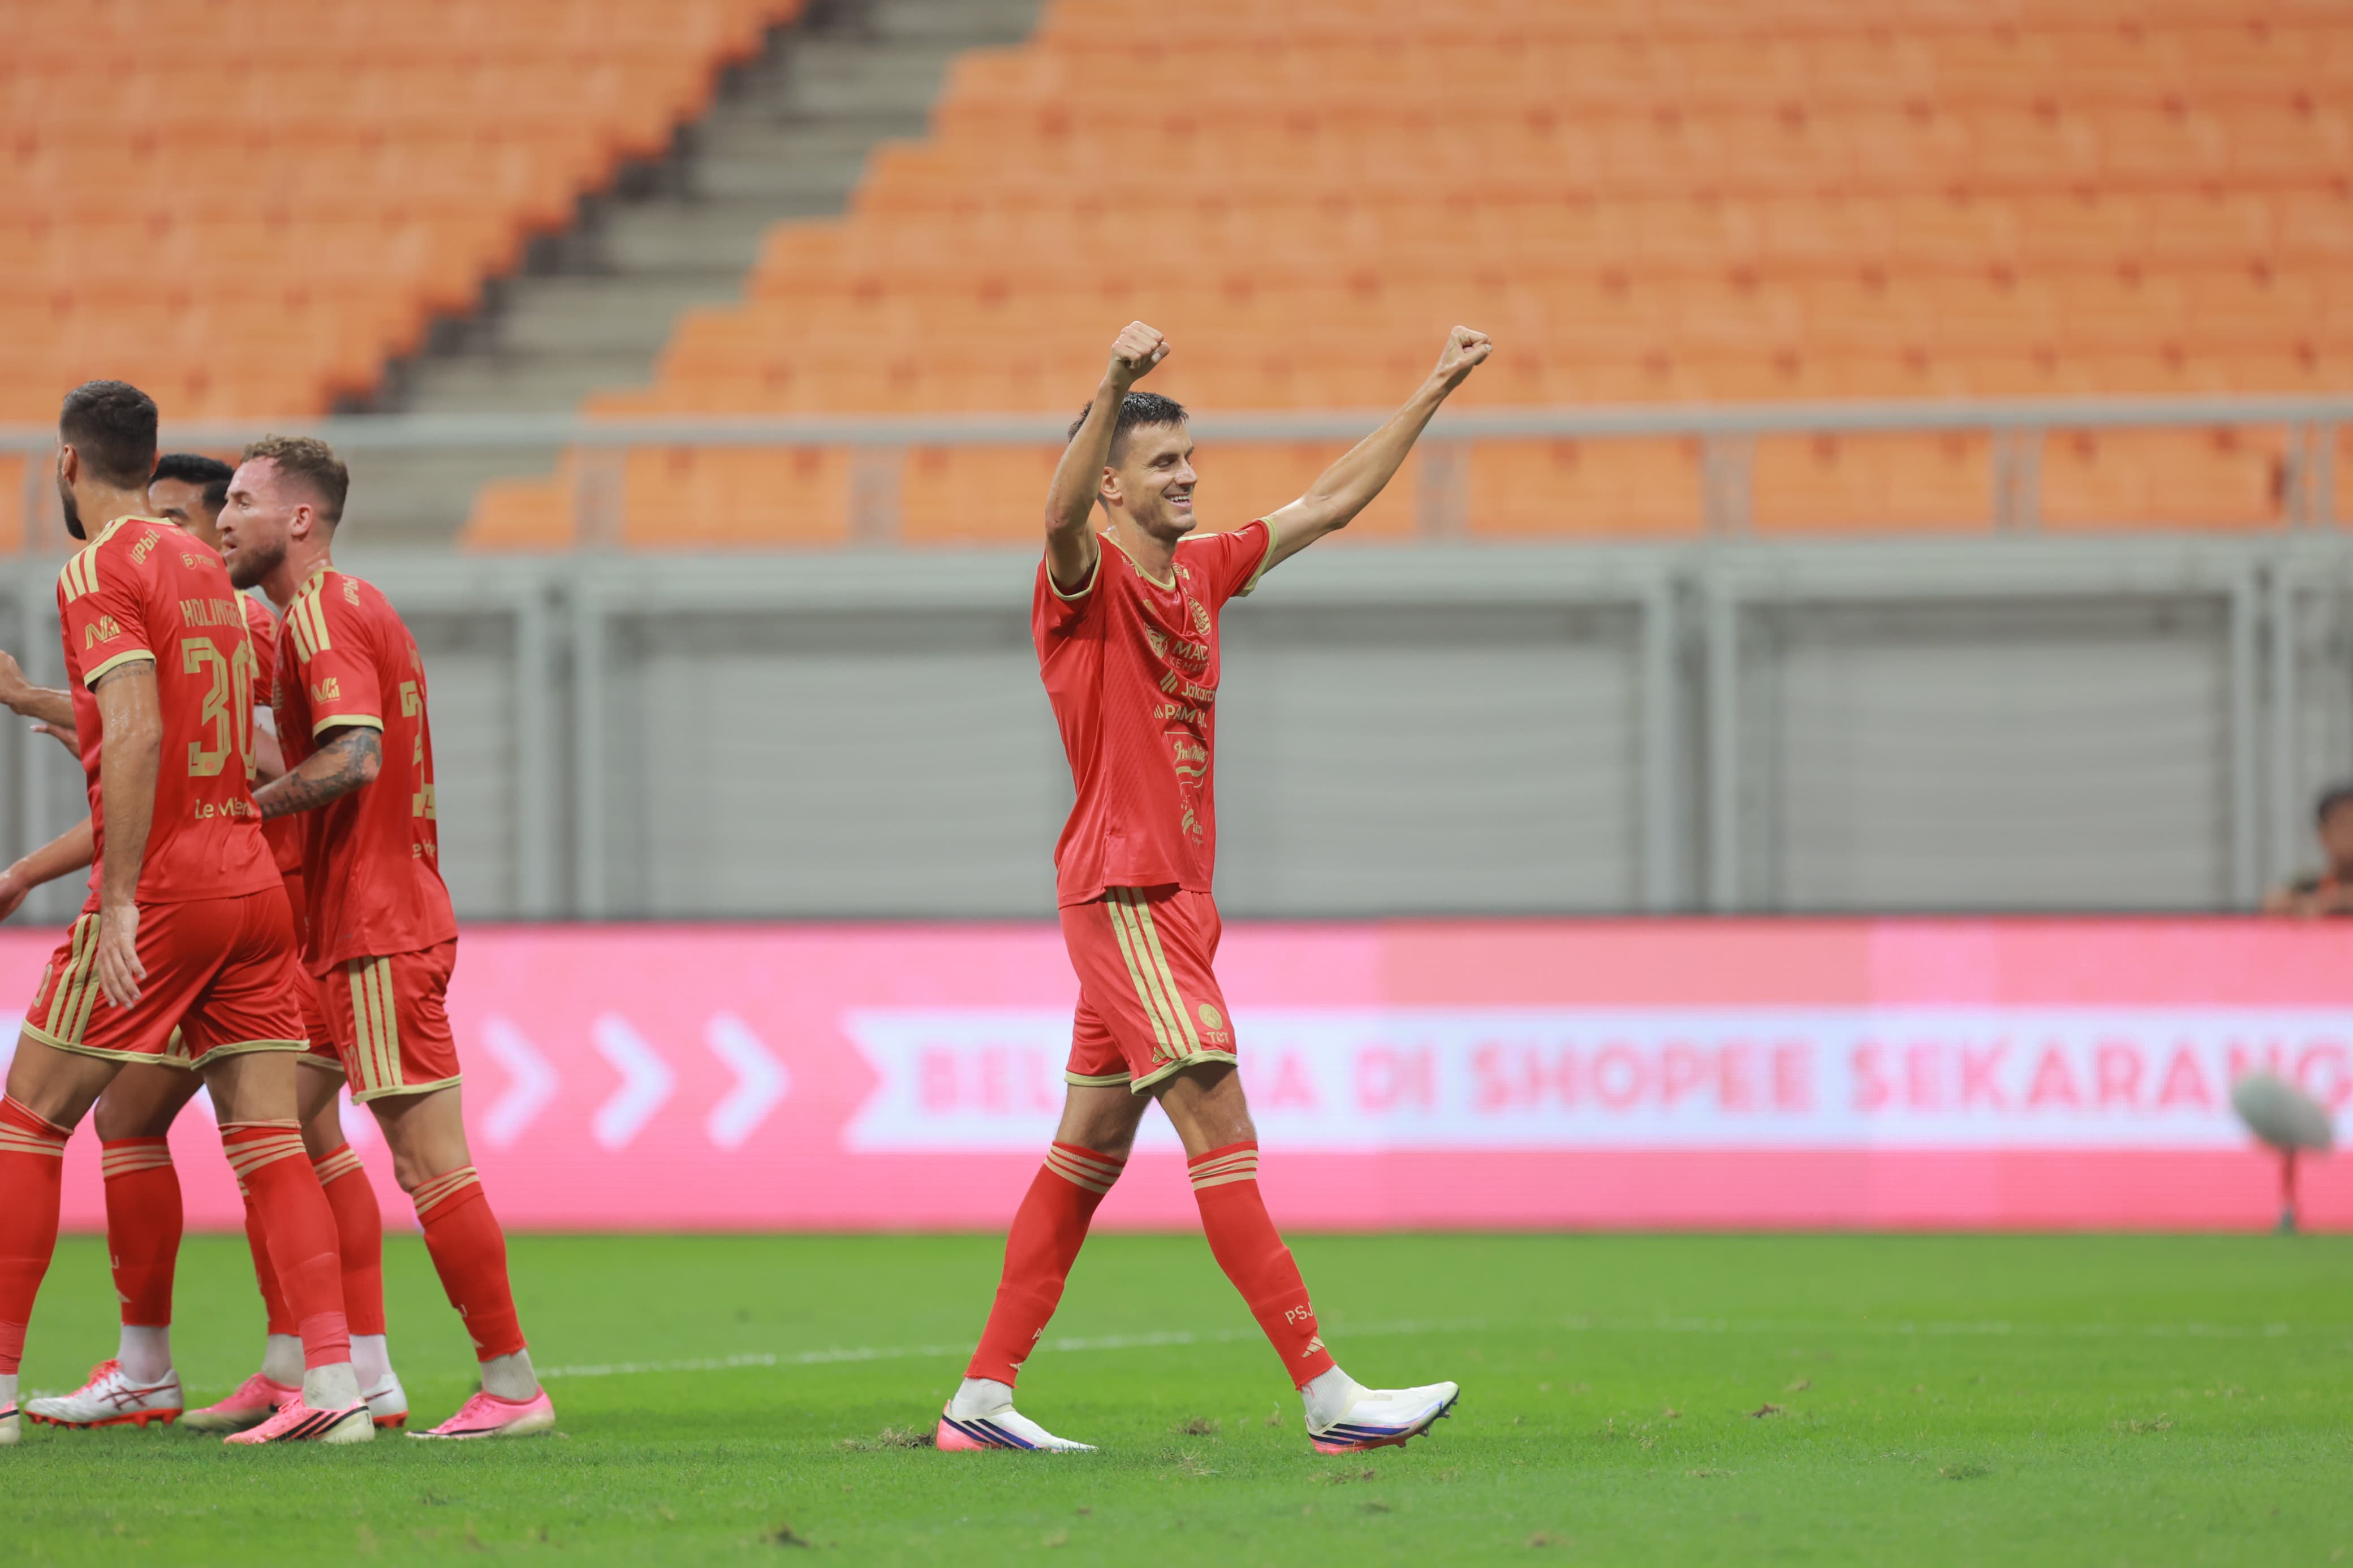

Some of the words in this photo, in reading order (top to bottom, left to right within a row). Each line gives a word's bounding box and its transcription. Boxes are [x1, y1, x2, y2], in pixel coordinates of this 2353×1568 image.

[1171, 640, 1212, 661] MAC
[181, 637, 257, 781] 30
[195, 799, 214, 819] Le
[1206, 1031, 1229, 1044] TCT
[1471, 1040, 1817, 1115] SHOPEE
